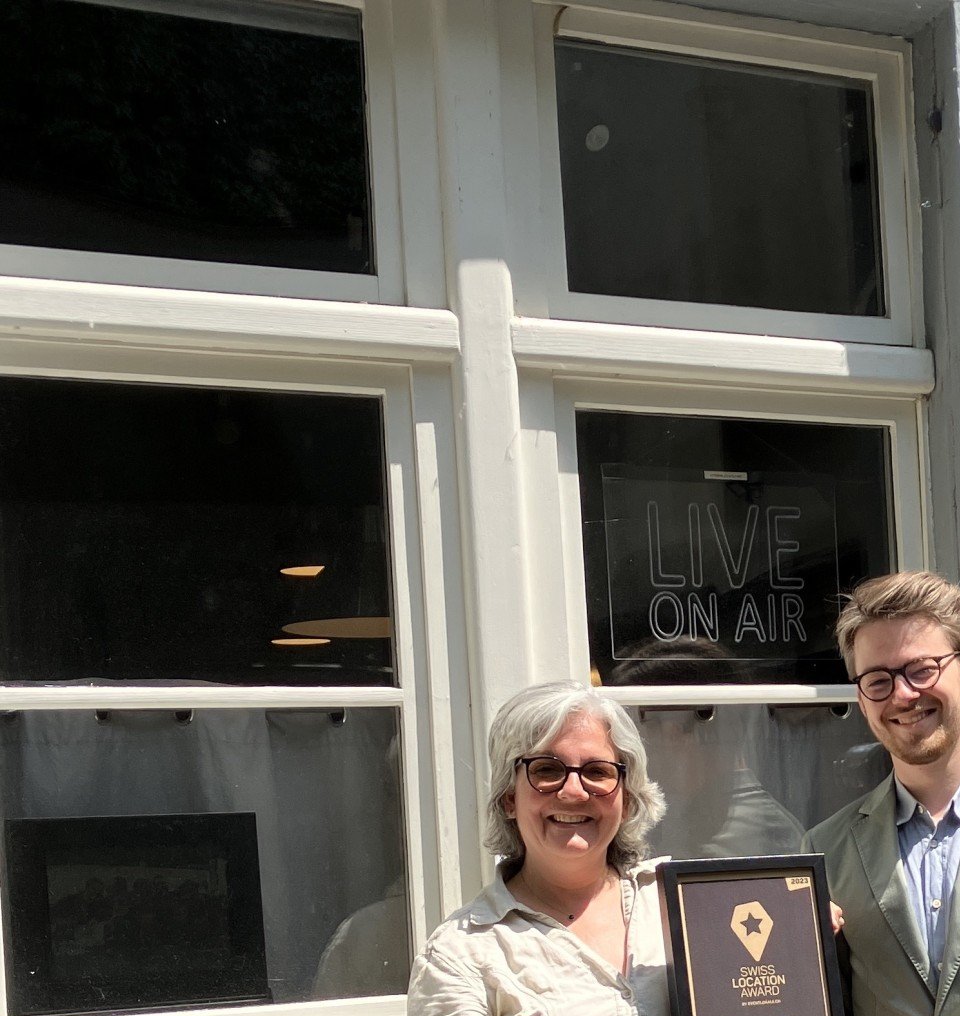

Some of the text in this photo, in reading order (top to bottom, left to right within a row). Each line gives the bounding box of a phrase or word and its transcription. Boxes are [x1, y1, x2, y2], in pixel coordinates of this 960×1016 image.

[647, 501, 805, 590] LIVE
[649, 590, 807, 644] ON AIR
[790, 877, 809, 885] 2023
[740, 964, 775, 977] SWISS
[732, 974, 786, 989] LOCATION
[740, 985, 780, 998] AWARD
